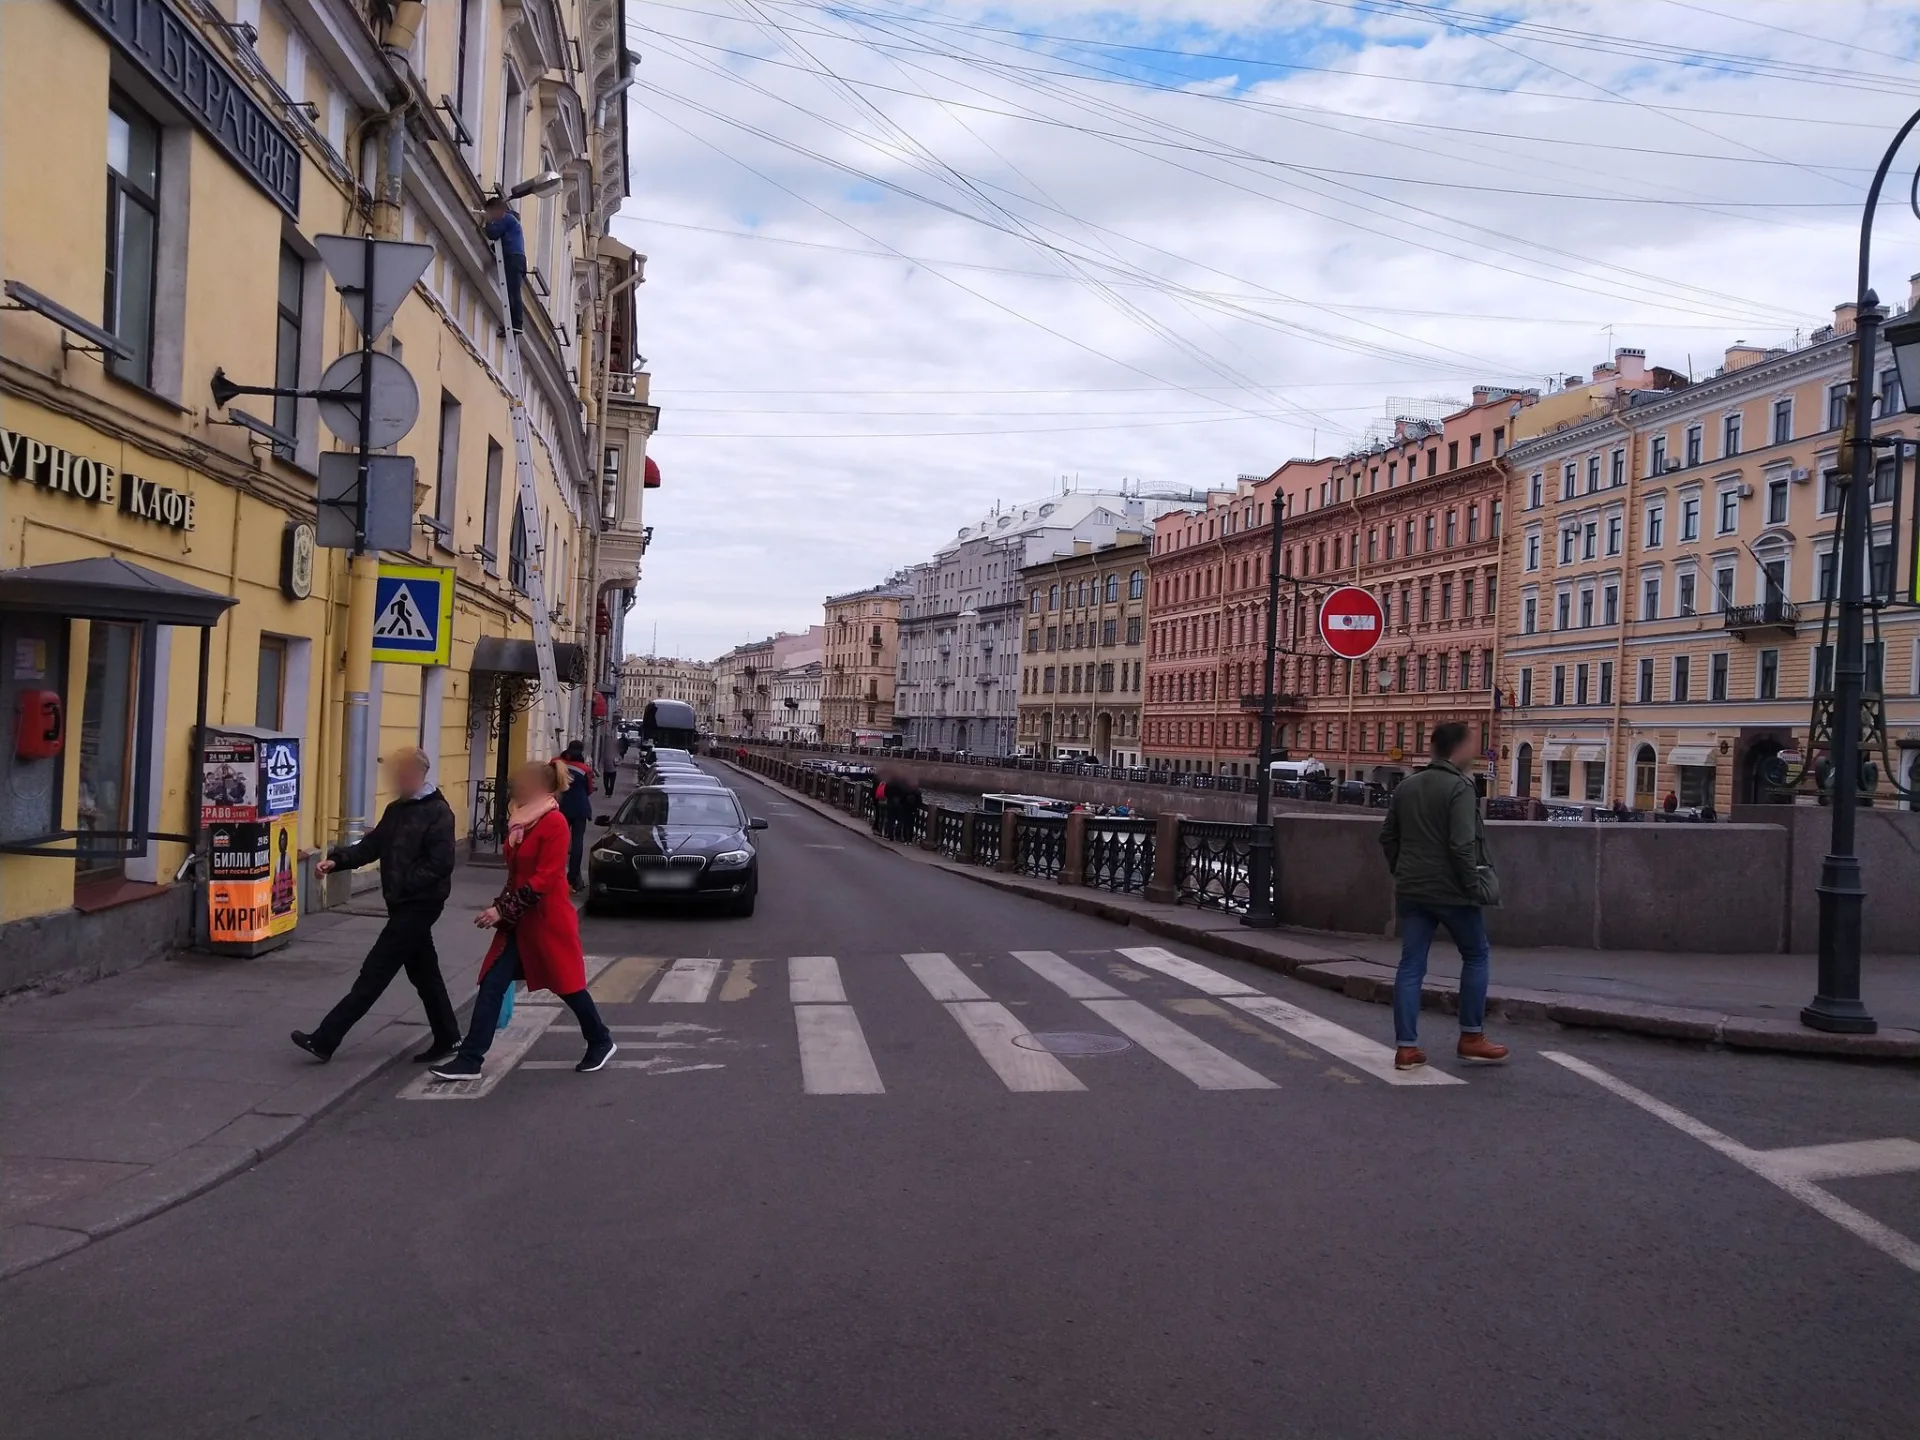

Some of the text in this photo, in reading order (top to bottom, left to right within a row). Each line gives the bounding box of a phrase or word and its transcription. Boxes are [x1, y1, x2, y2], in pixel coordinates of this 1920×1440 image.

[160, 9, 296, 207] БЕРАНЖЕ
[0, 427, 196, 532] УРНОЕ КАФЕ
[214, 852, 251, 868] БИЛЛИ
